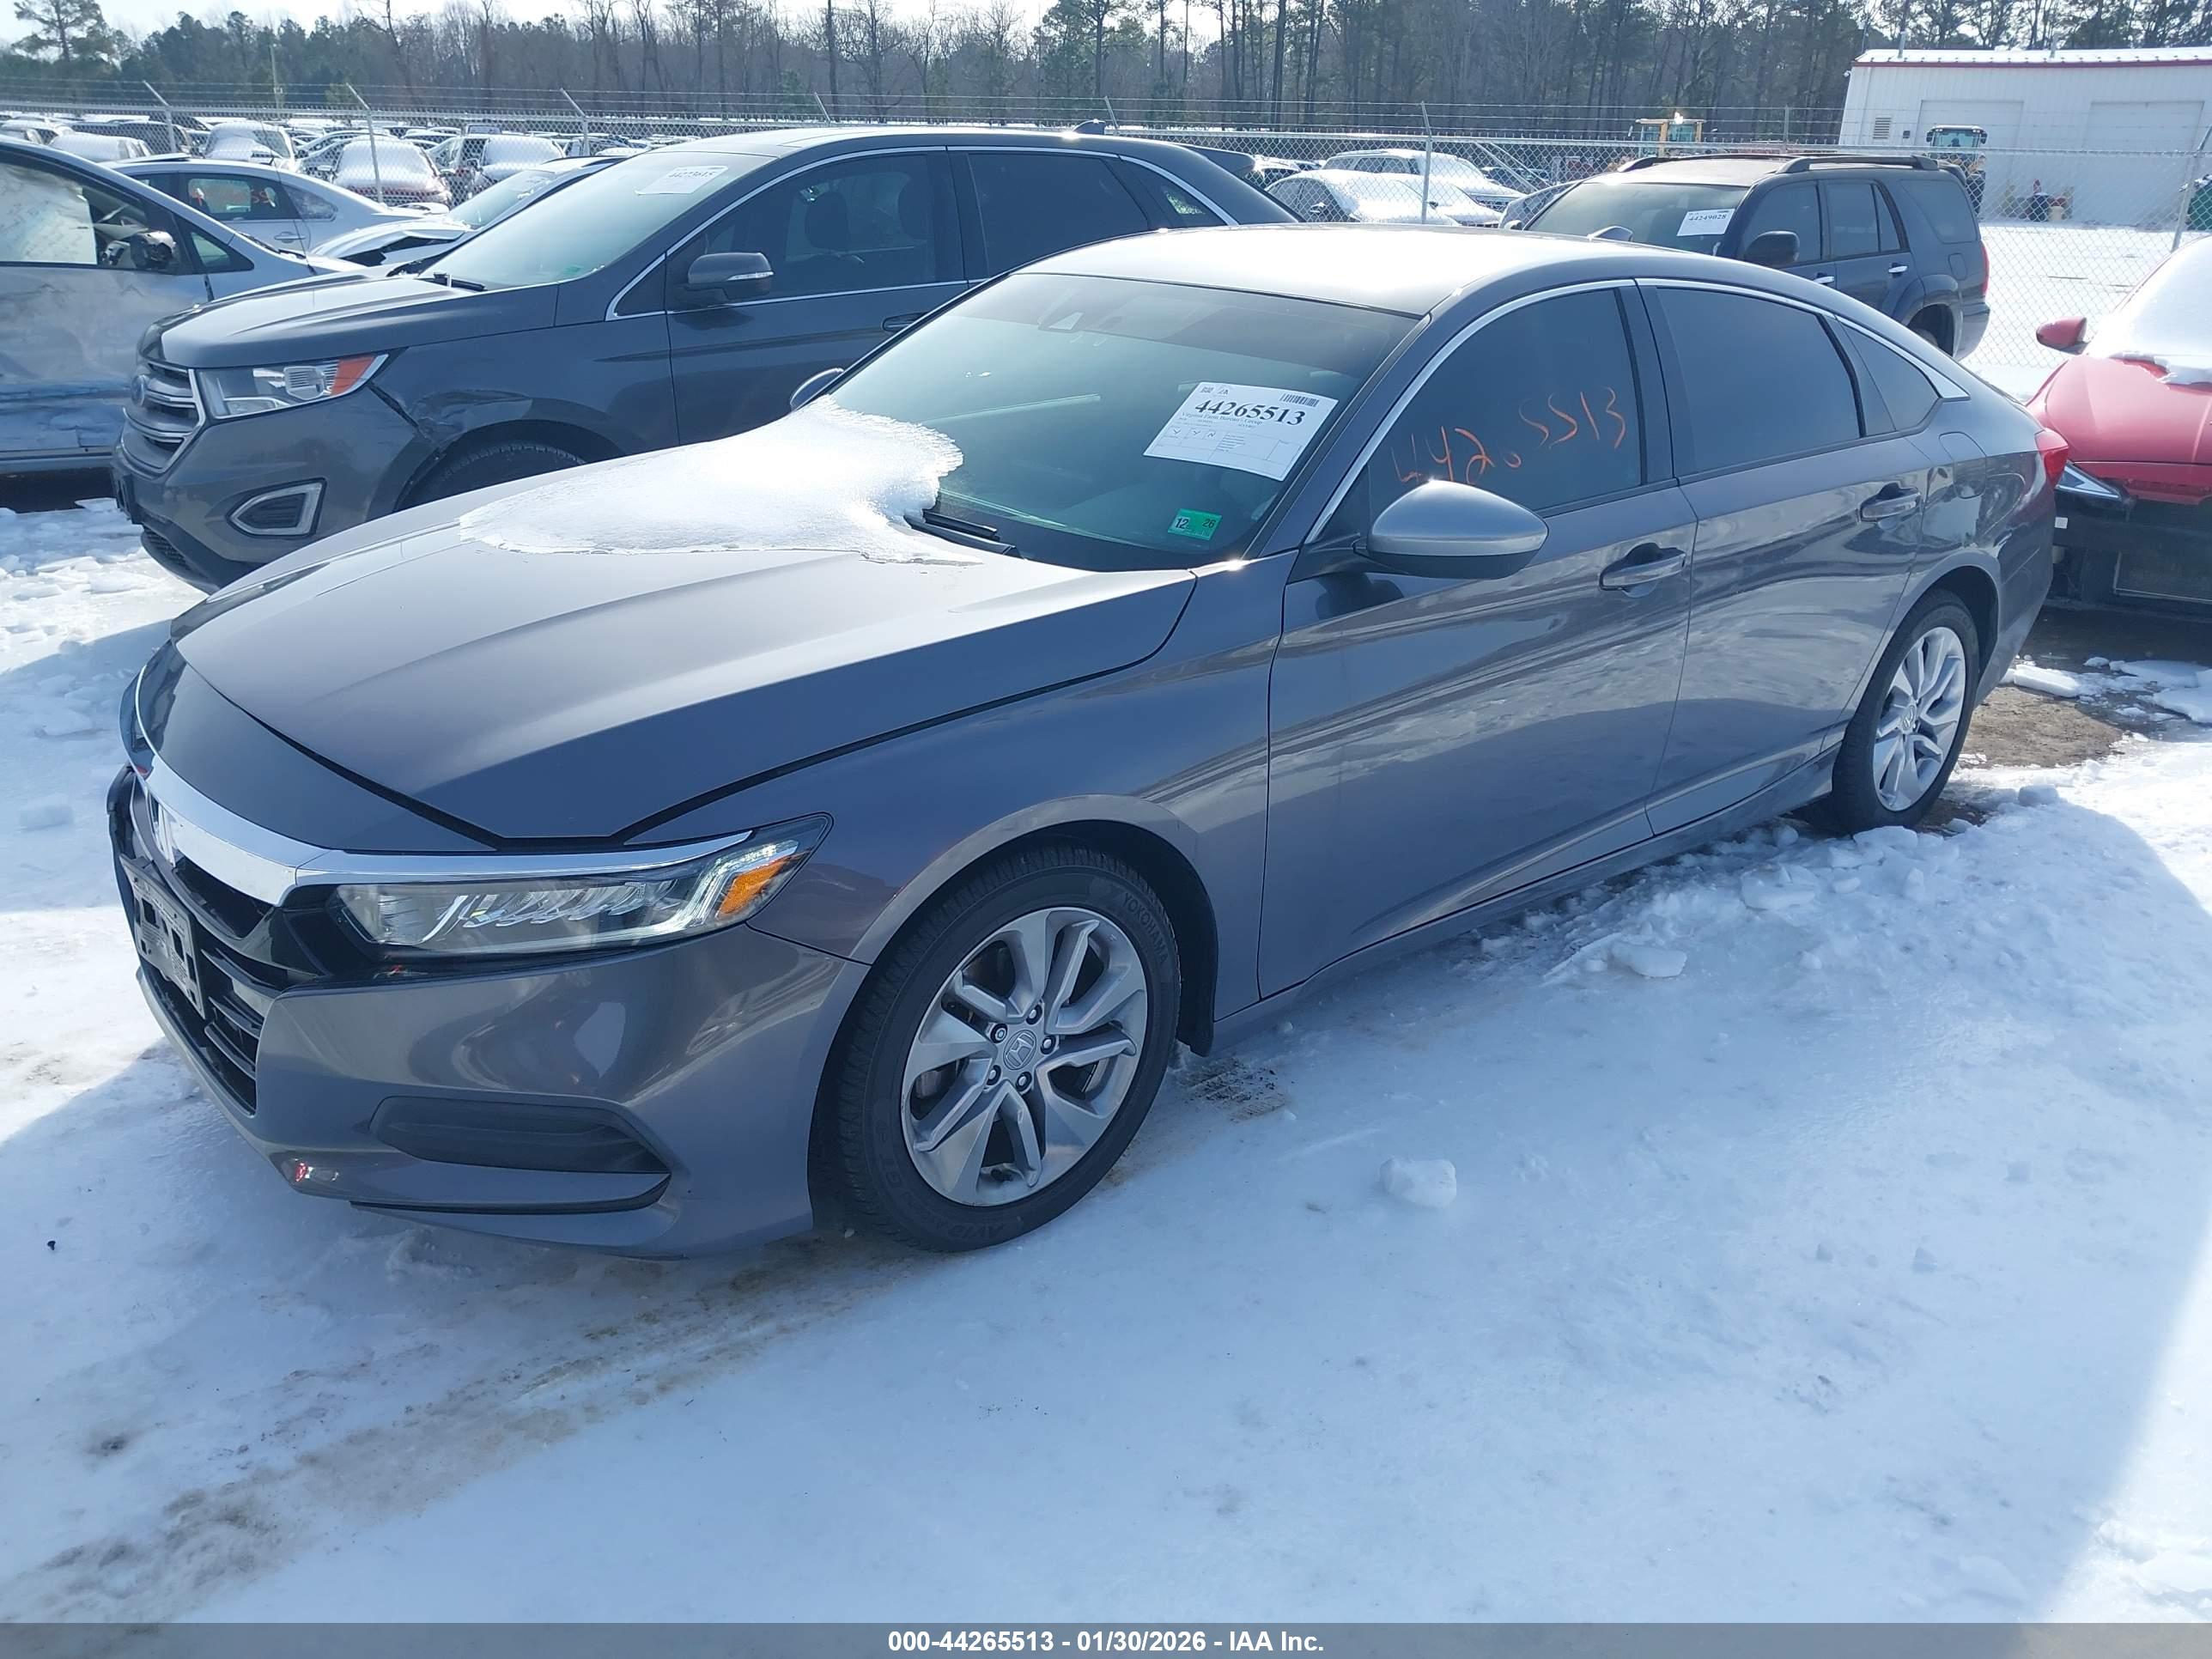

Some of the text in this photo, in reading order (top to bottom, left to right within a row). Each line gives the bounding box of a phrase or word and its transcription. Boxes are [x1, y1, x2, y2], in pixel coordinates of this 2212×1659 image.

[1194, 399, 1306, 425] 44265513
[1175, 517, 1189, 529] 12
[1202, 518, 1216, 528] 26
[1122, 892, 1169, 965] YOKOHAMA
